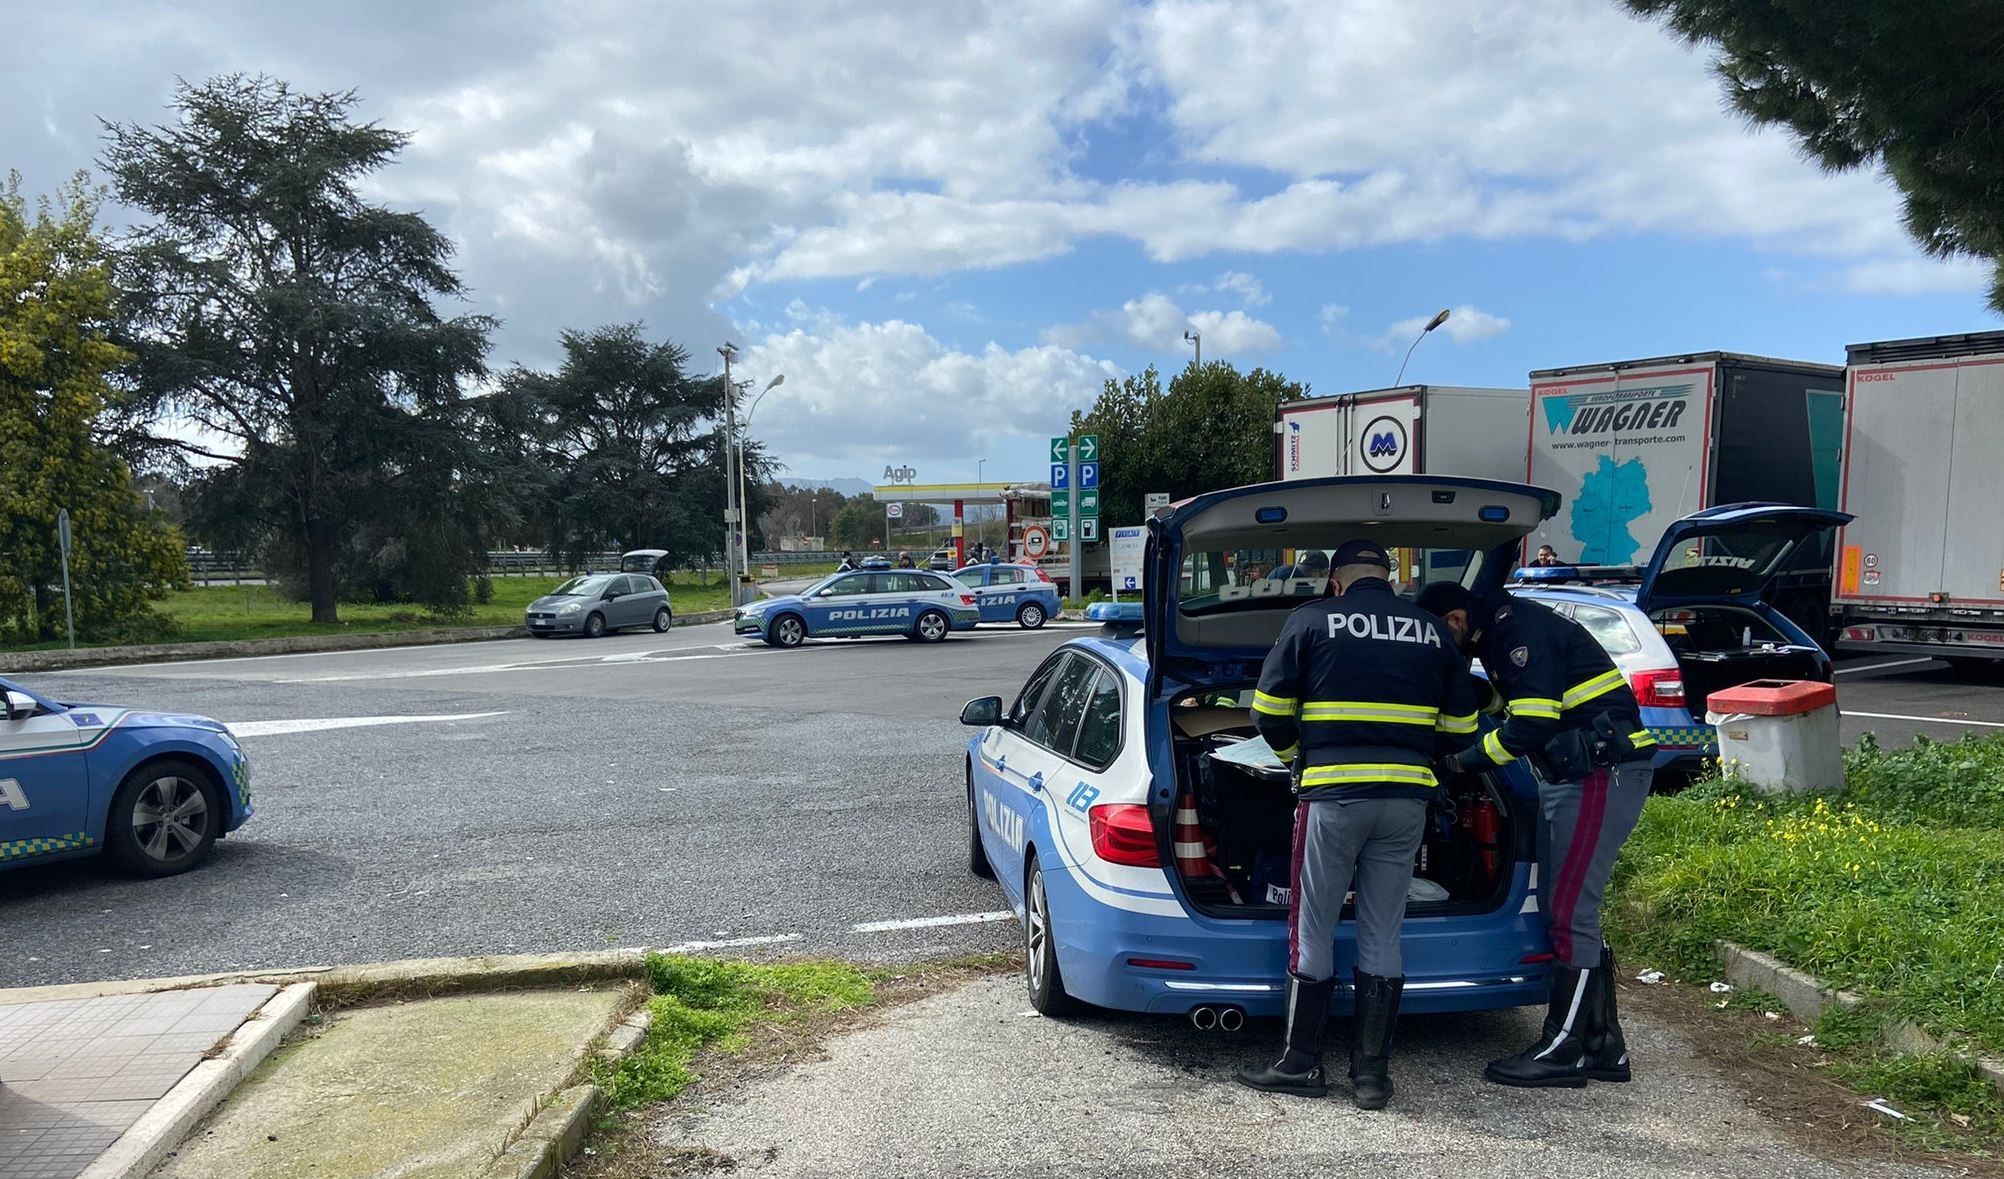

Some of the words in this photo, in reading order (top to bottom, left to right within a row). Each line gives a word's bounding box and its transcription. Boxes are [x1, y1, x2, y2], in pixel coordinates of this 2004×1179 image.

[1571, 400, 1686, 434] WAGNER
[883, 465, 917, 483] Agip
[1055, 467, 1066, 487] P
[1083, 465, 1094, 486] P
[980, 595, 1016, 607] IZIA
[828, 607, 910, 621] POLIZIA
[1327, 613, 1441, 649] POLIZIA
[1066, 781, 1101, 814] 113
[983, 788, 1025, 859] POLIZIA
[1273, 887, 1292, 904] Poli
